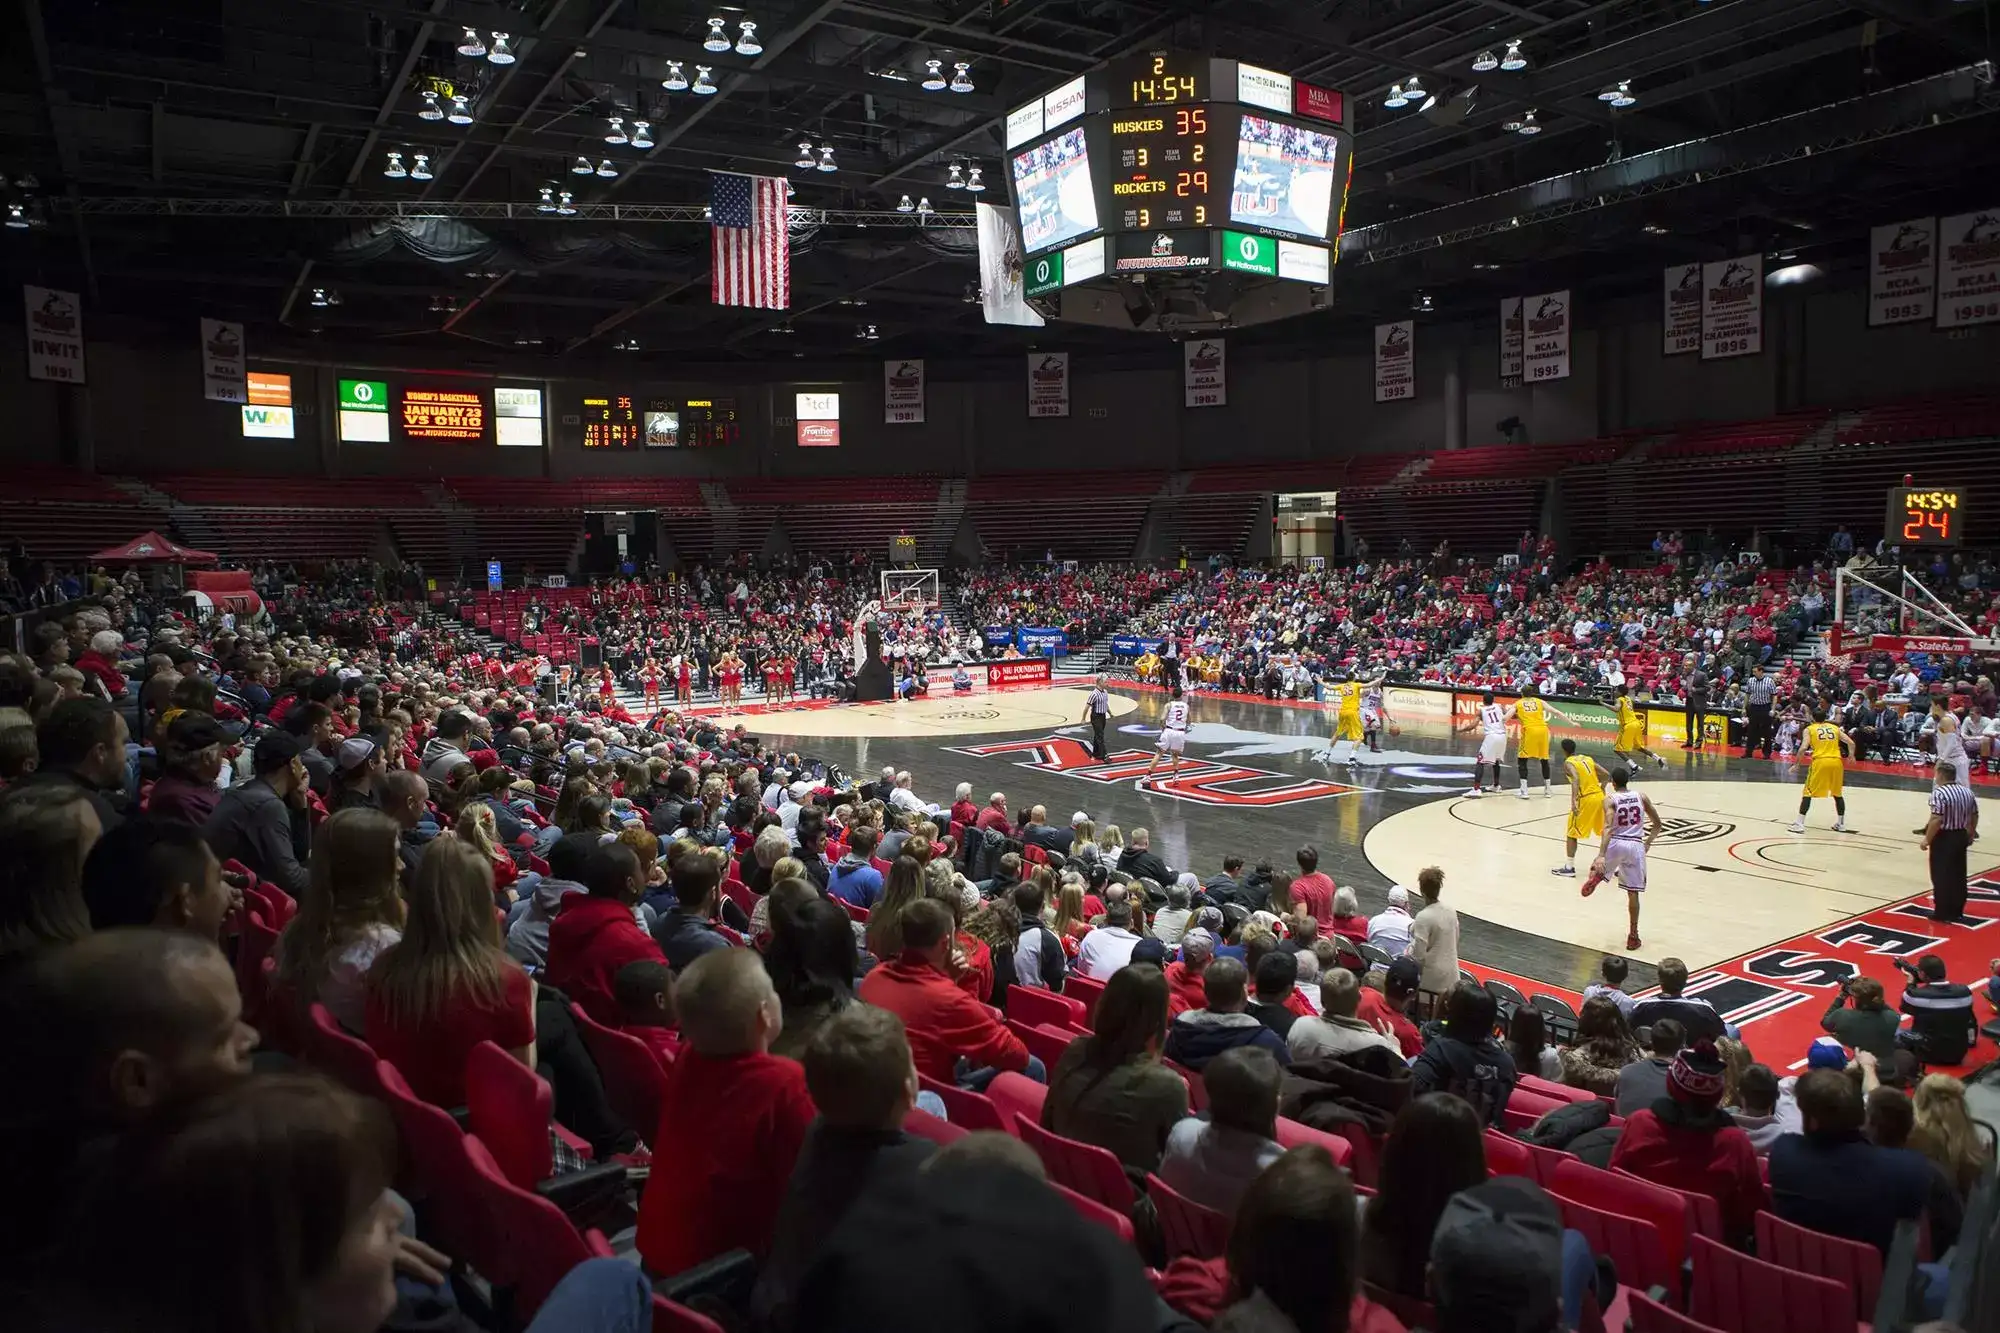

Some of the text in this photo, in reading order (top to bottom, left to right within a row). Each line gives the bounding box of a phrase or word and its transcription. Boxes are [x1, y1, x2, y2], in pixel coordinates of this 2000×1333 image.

[1154, 58, 1163, 74] 2
[1133, 77, 1194, 102] 14:54
[1309, 88, 1329, 104] MBA
[1046, 90, 1084, 117] NISSAN
[1113, 110, 1206, 135] HUSKIES 35
[1138, 149, 1148, 166] 3
[1193, 145, 1204, 162] 2
[1114, 172, 1207, 196] ROCKETS 29
[1140, 209, 1150, 226] 3
[1196, 206, 1205, 223] 3
[1259, 227, 1297, 240] DAKTRONICS
[1116, 256, 1210, 270] NIUHUSKIES.COM
[1535, 341, 1558, 352] NCAA
[1534, 365, 1559, 377] 1995
[429, 394, 479, 403] BASKETBALL
[1384, 386, 1406, 397] 1995
[618, 397, 632, 408] 35
[404, 405, 482, 417] JANUARY 23
[603, 410, 632, 420] 2 3
[404, 415, 481, 427] VS OHIO
[646, 432, 677, 443] NIU
[1906, 492, 1957, 510] 14:54
[1904, 511, 1948, 539] 24
[550, 577, 564, 585] 107
[1003, 664, 1047, 675] NIU FOUNDATION
[1175, 709, 1183, 721] 2
[1488, 712, 1500, 724] 11
[1569, 710, 1620, 725] National Ban
[1818, 728, 1835, 740] 25
[1583, 760, 1591, 774] 1
[1617, 806, 1641, 826] 23
